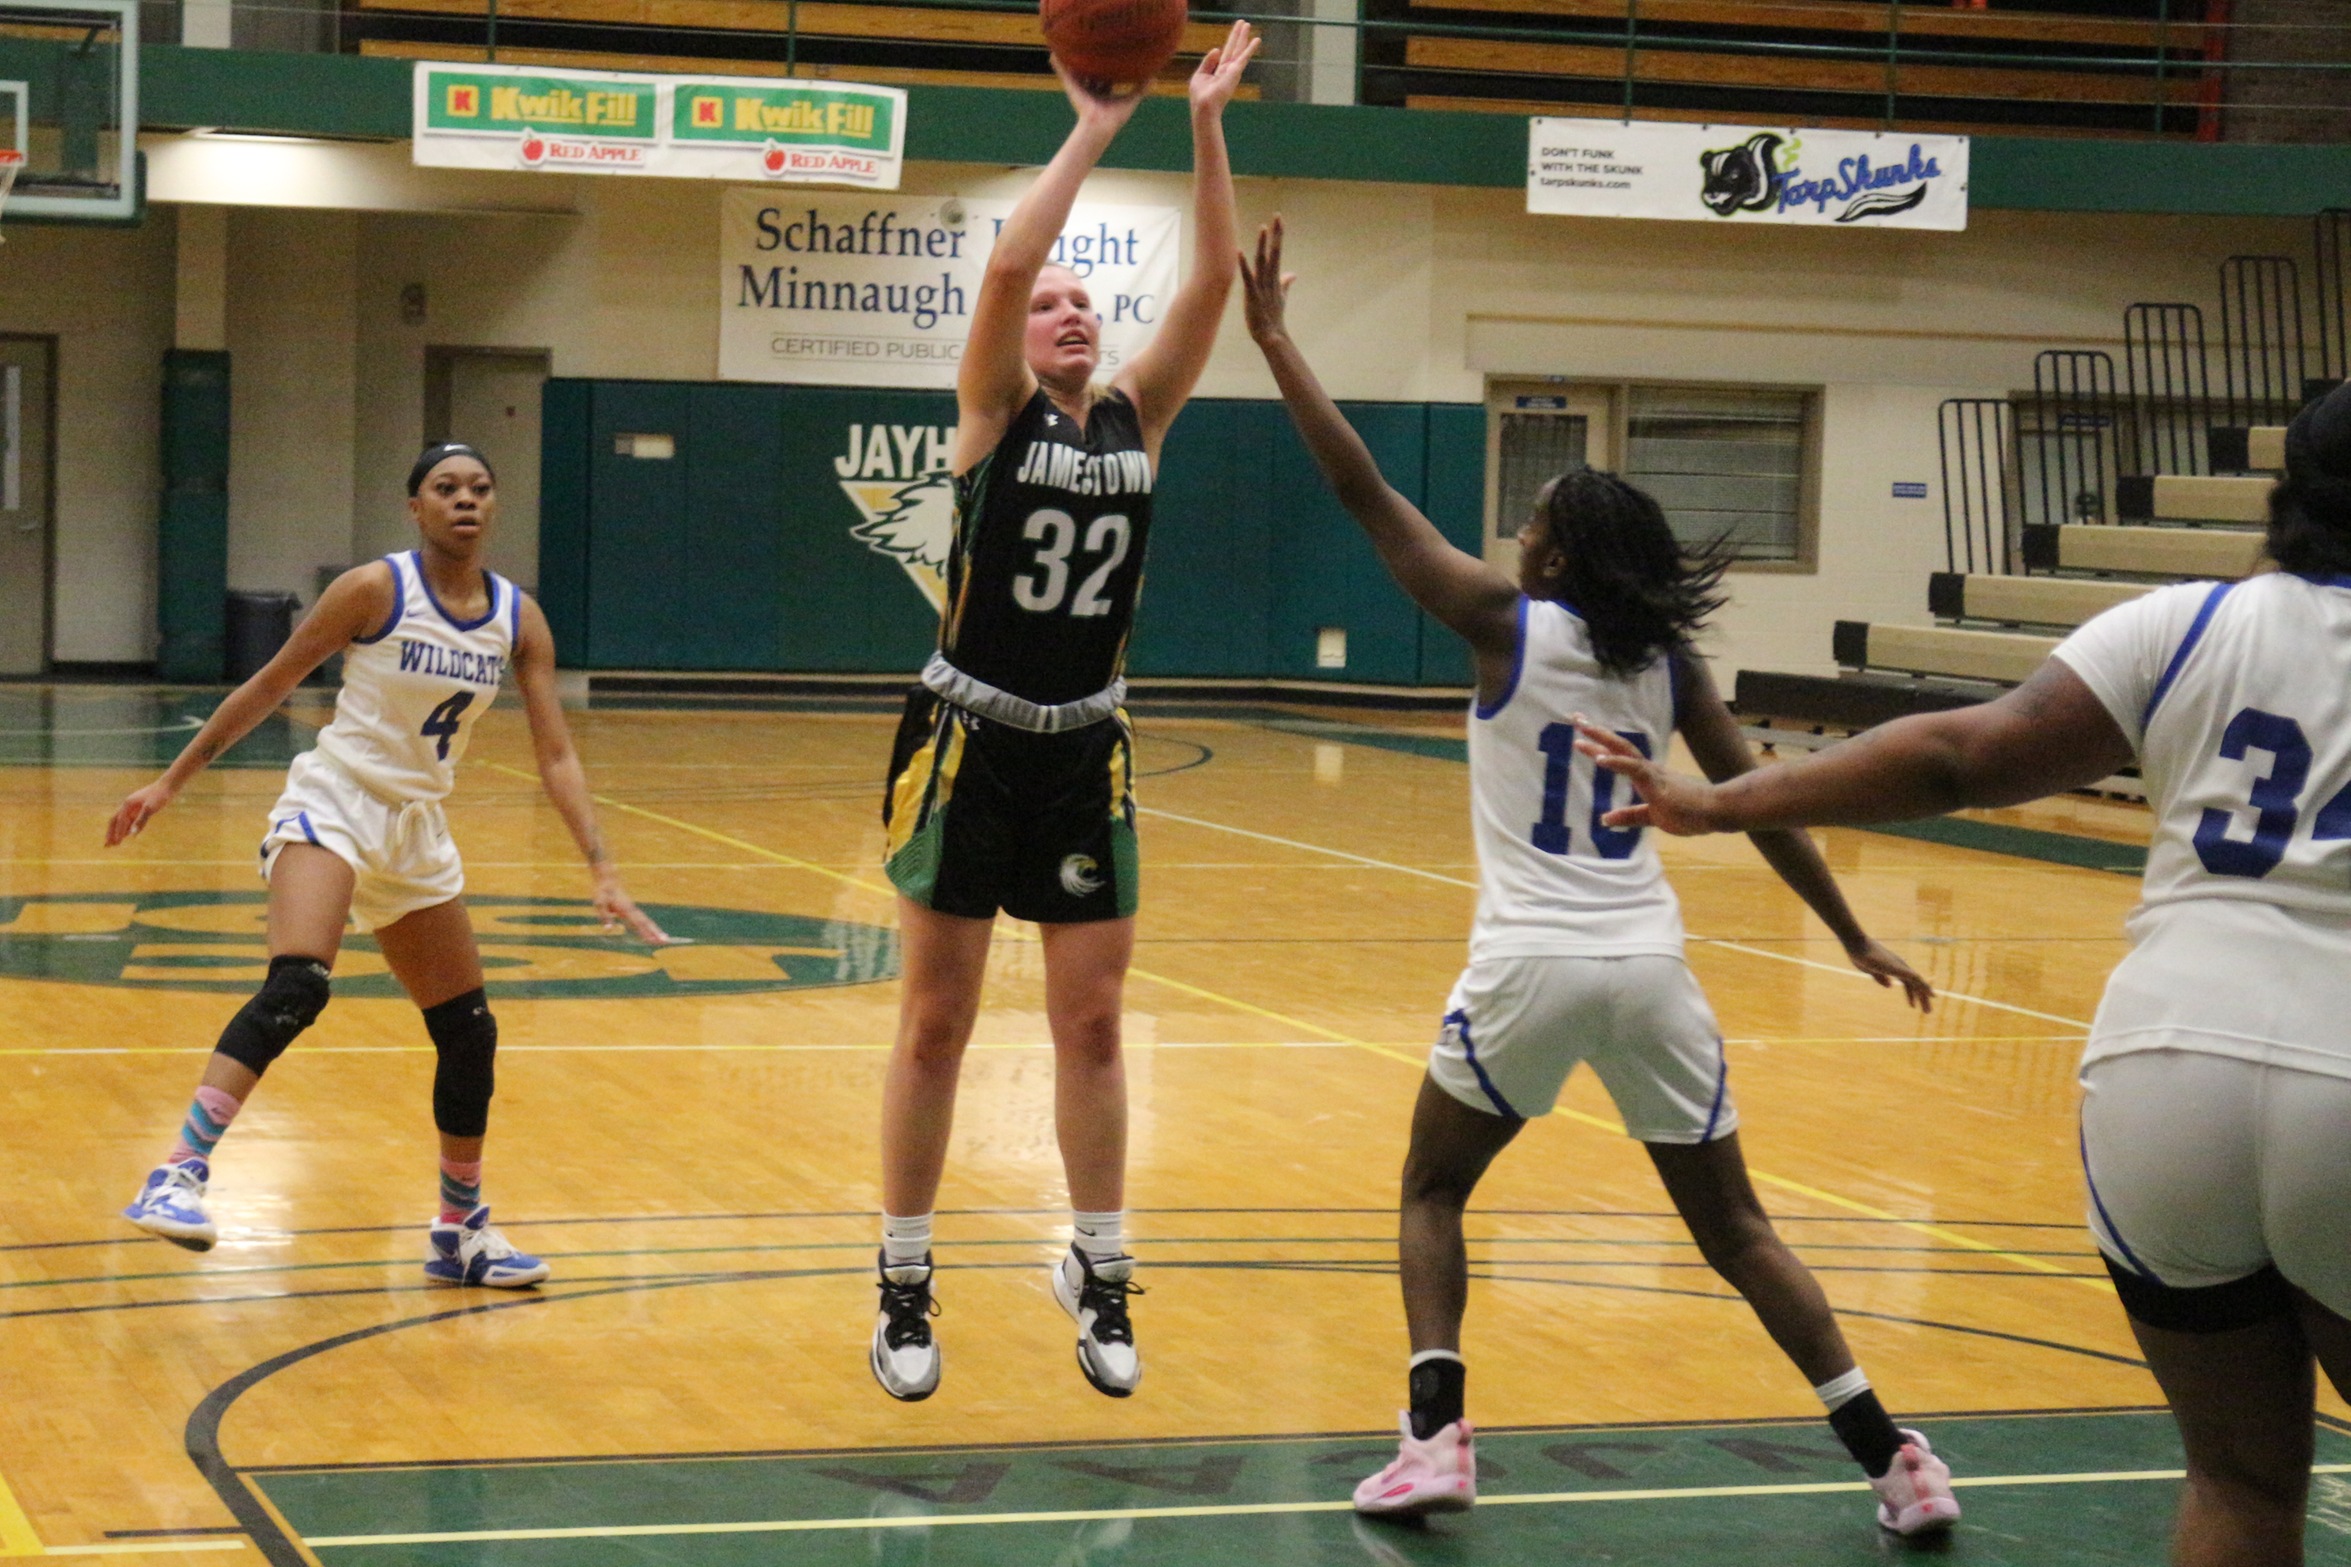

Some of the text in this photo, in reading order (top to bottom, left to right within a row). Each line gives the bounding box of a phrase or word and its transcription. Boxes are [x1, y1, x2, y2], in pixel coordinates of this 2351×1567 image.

[453, 90, 472, 111] K
[491, 86, 637, 127] Kwik Fill
[699, 102, 717, 123] K
[735, 97, 875, 139] Kwik Fill
[549, 143, 642, 162] RED APPLE
[790, 153, 876, 174] RED APPLE
[1541, 147, 1616, 159] DON'T FUNK
[1541, 162, 1644, 175] WITH THE SKUNK
[1540, 177, 1632, 190] tarpskunks.com
[756, 207, 1140, 280] Schaffner ight
[738, 264, 1156, 330] Minnaugh PC
[771, 337, 961, 360] CERTIFIED PUBLIC
[834, 424, 957, 480] JAYH
[1012, 508, 1133, 617] 32
[420, 690, 475, 762] 4
